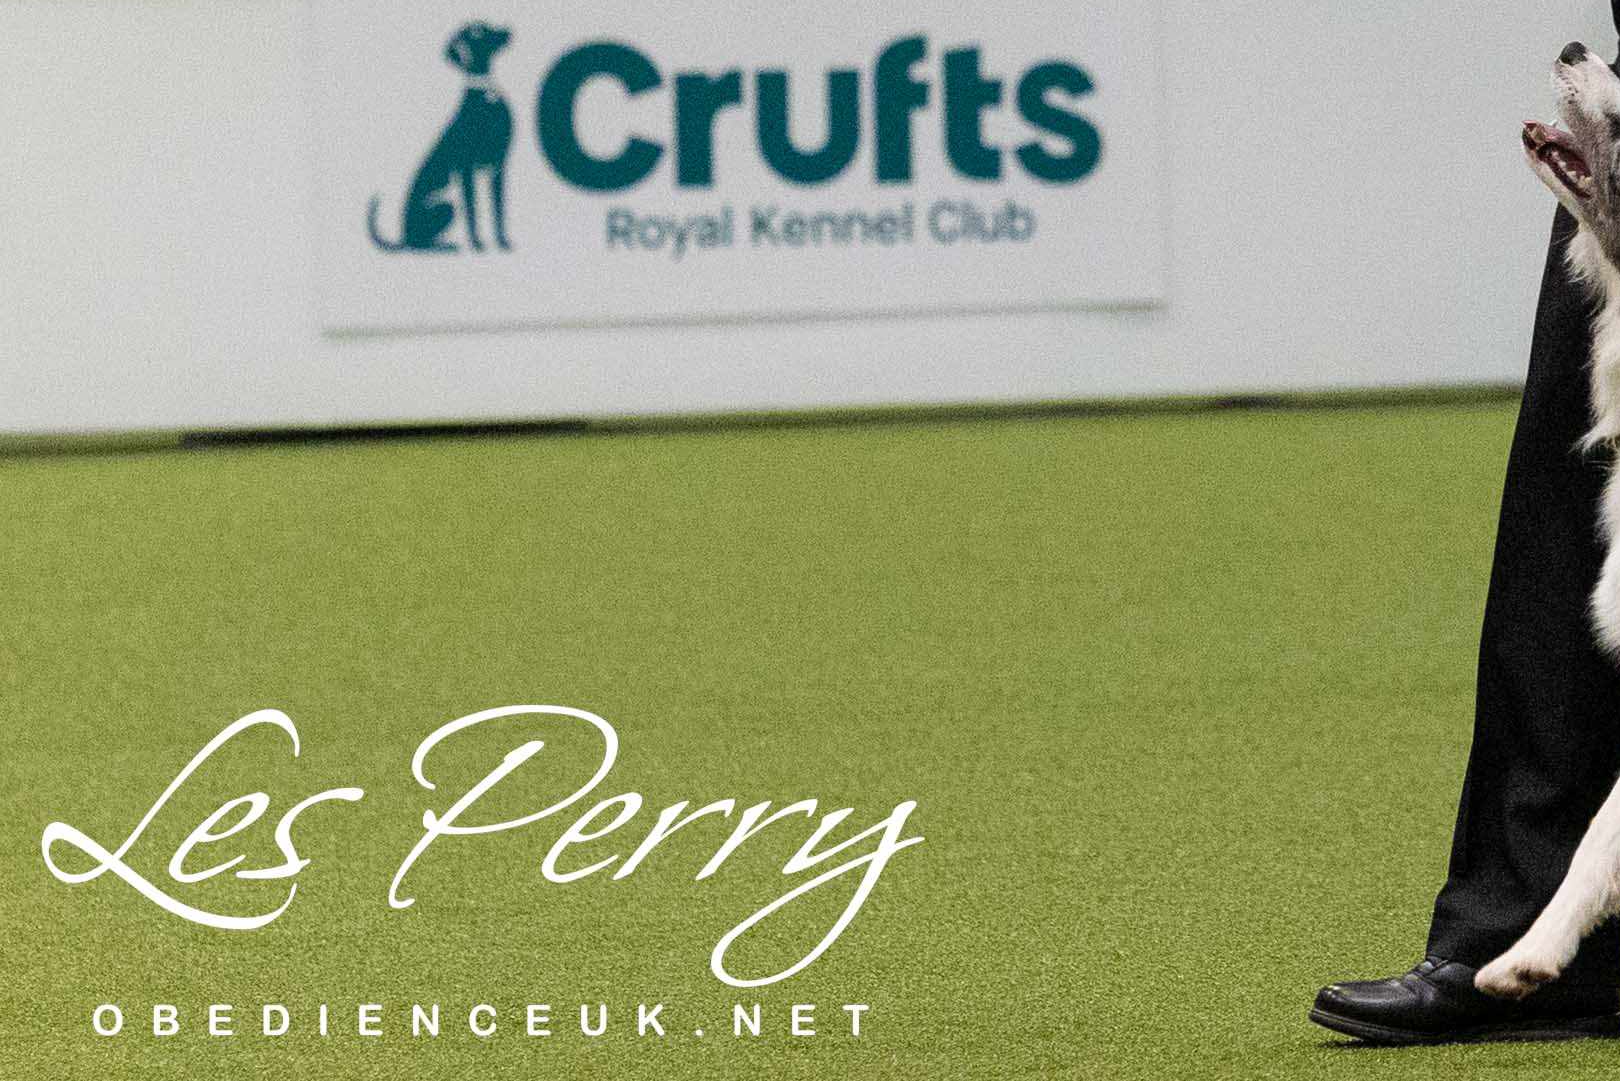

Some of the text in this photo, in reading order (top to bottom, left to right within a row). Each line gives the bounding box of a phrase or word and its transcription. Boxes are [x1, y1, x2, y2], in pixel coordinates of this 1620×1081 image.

[534, 34, 1104, 195] Crufts
[605, 200, 1037, 260] Royal Kennel Club
